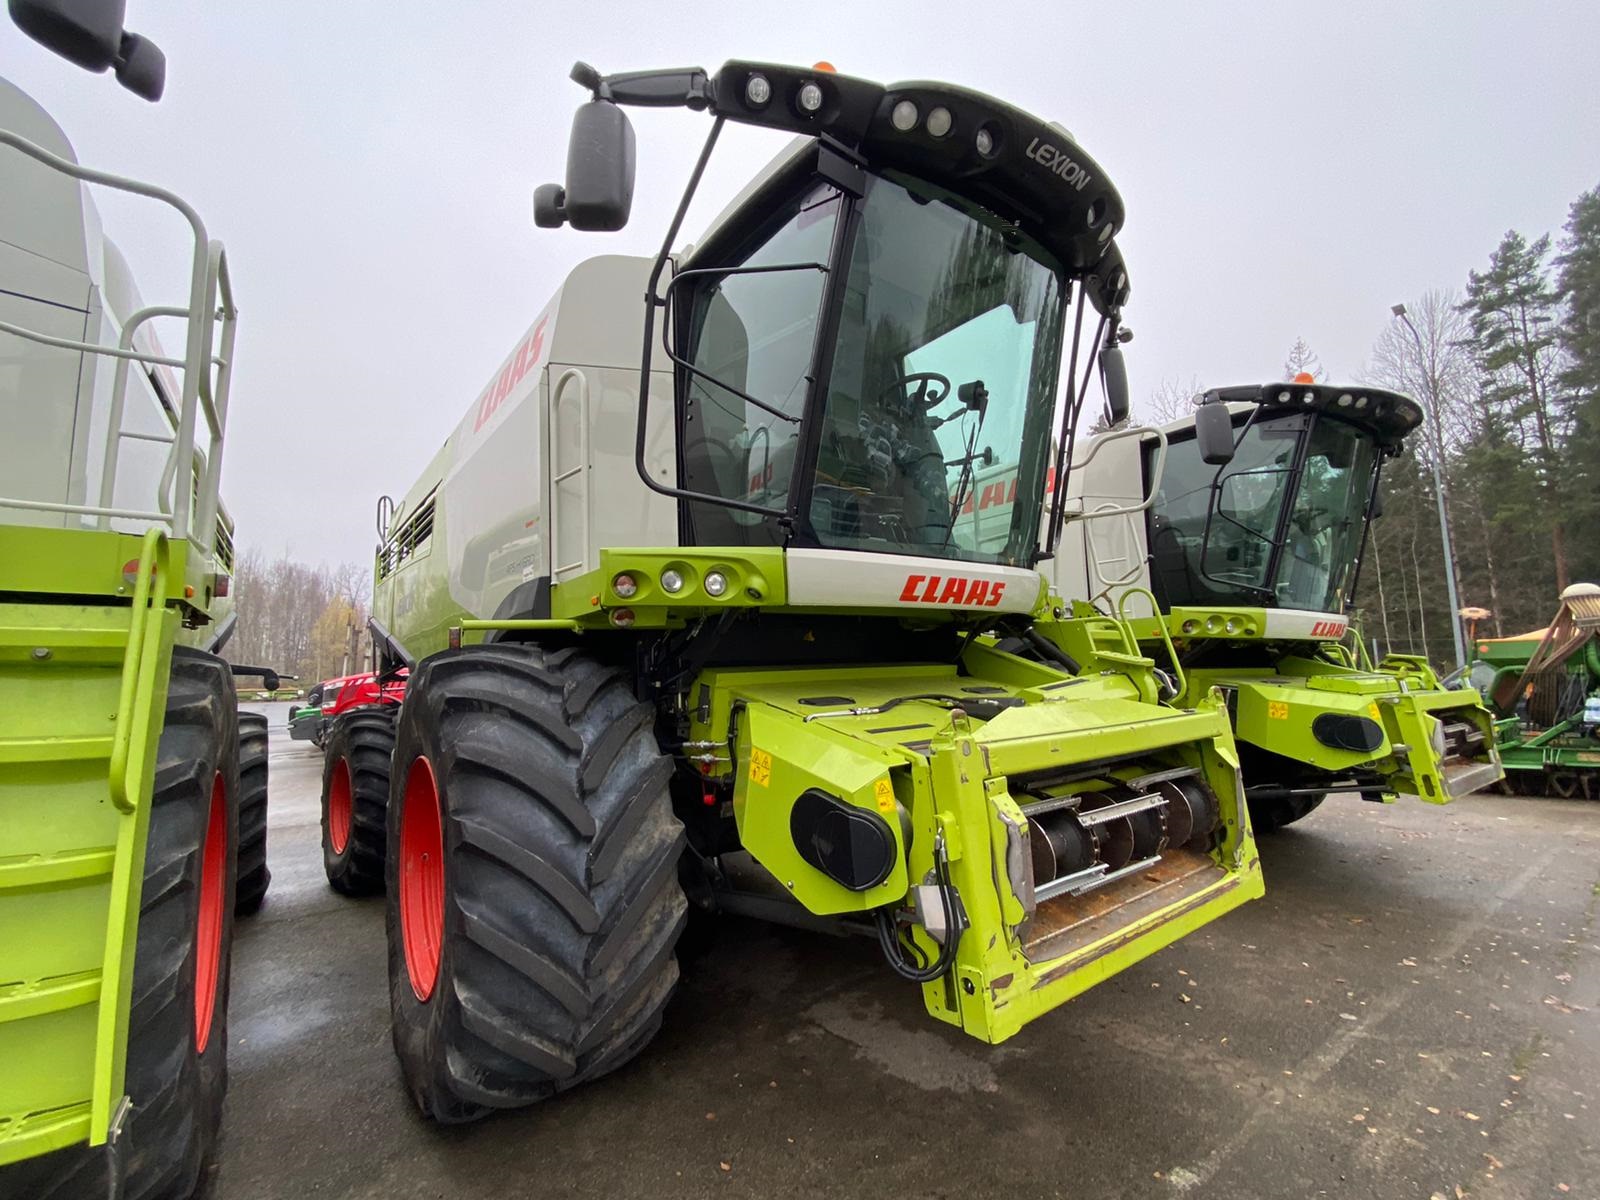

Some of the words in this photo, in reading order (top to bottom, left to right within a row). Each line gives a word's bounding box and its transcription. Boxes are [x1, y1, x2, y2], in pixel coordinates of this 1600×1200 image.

[1026, 137, 1091, 191] LEXION
[473, 313, 550, 433] CLAAS
[899, 575, 1006, 607] CLAAS
[1311, 622, 1346, 638] CLAAS
